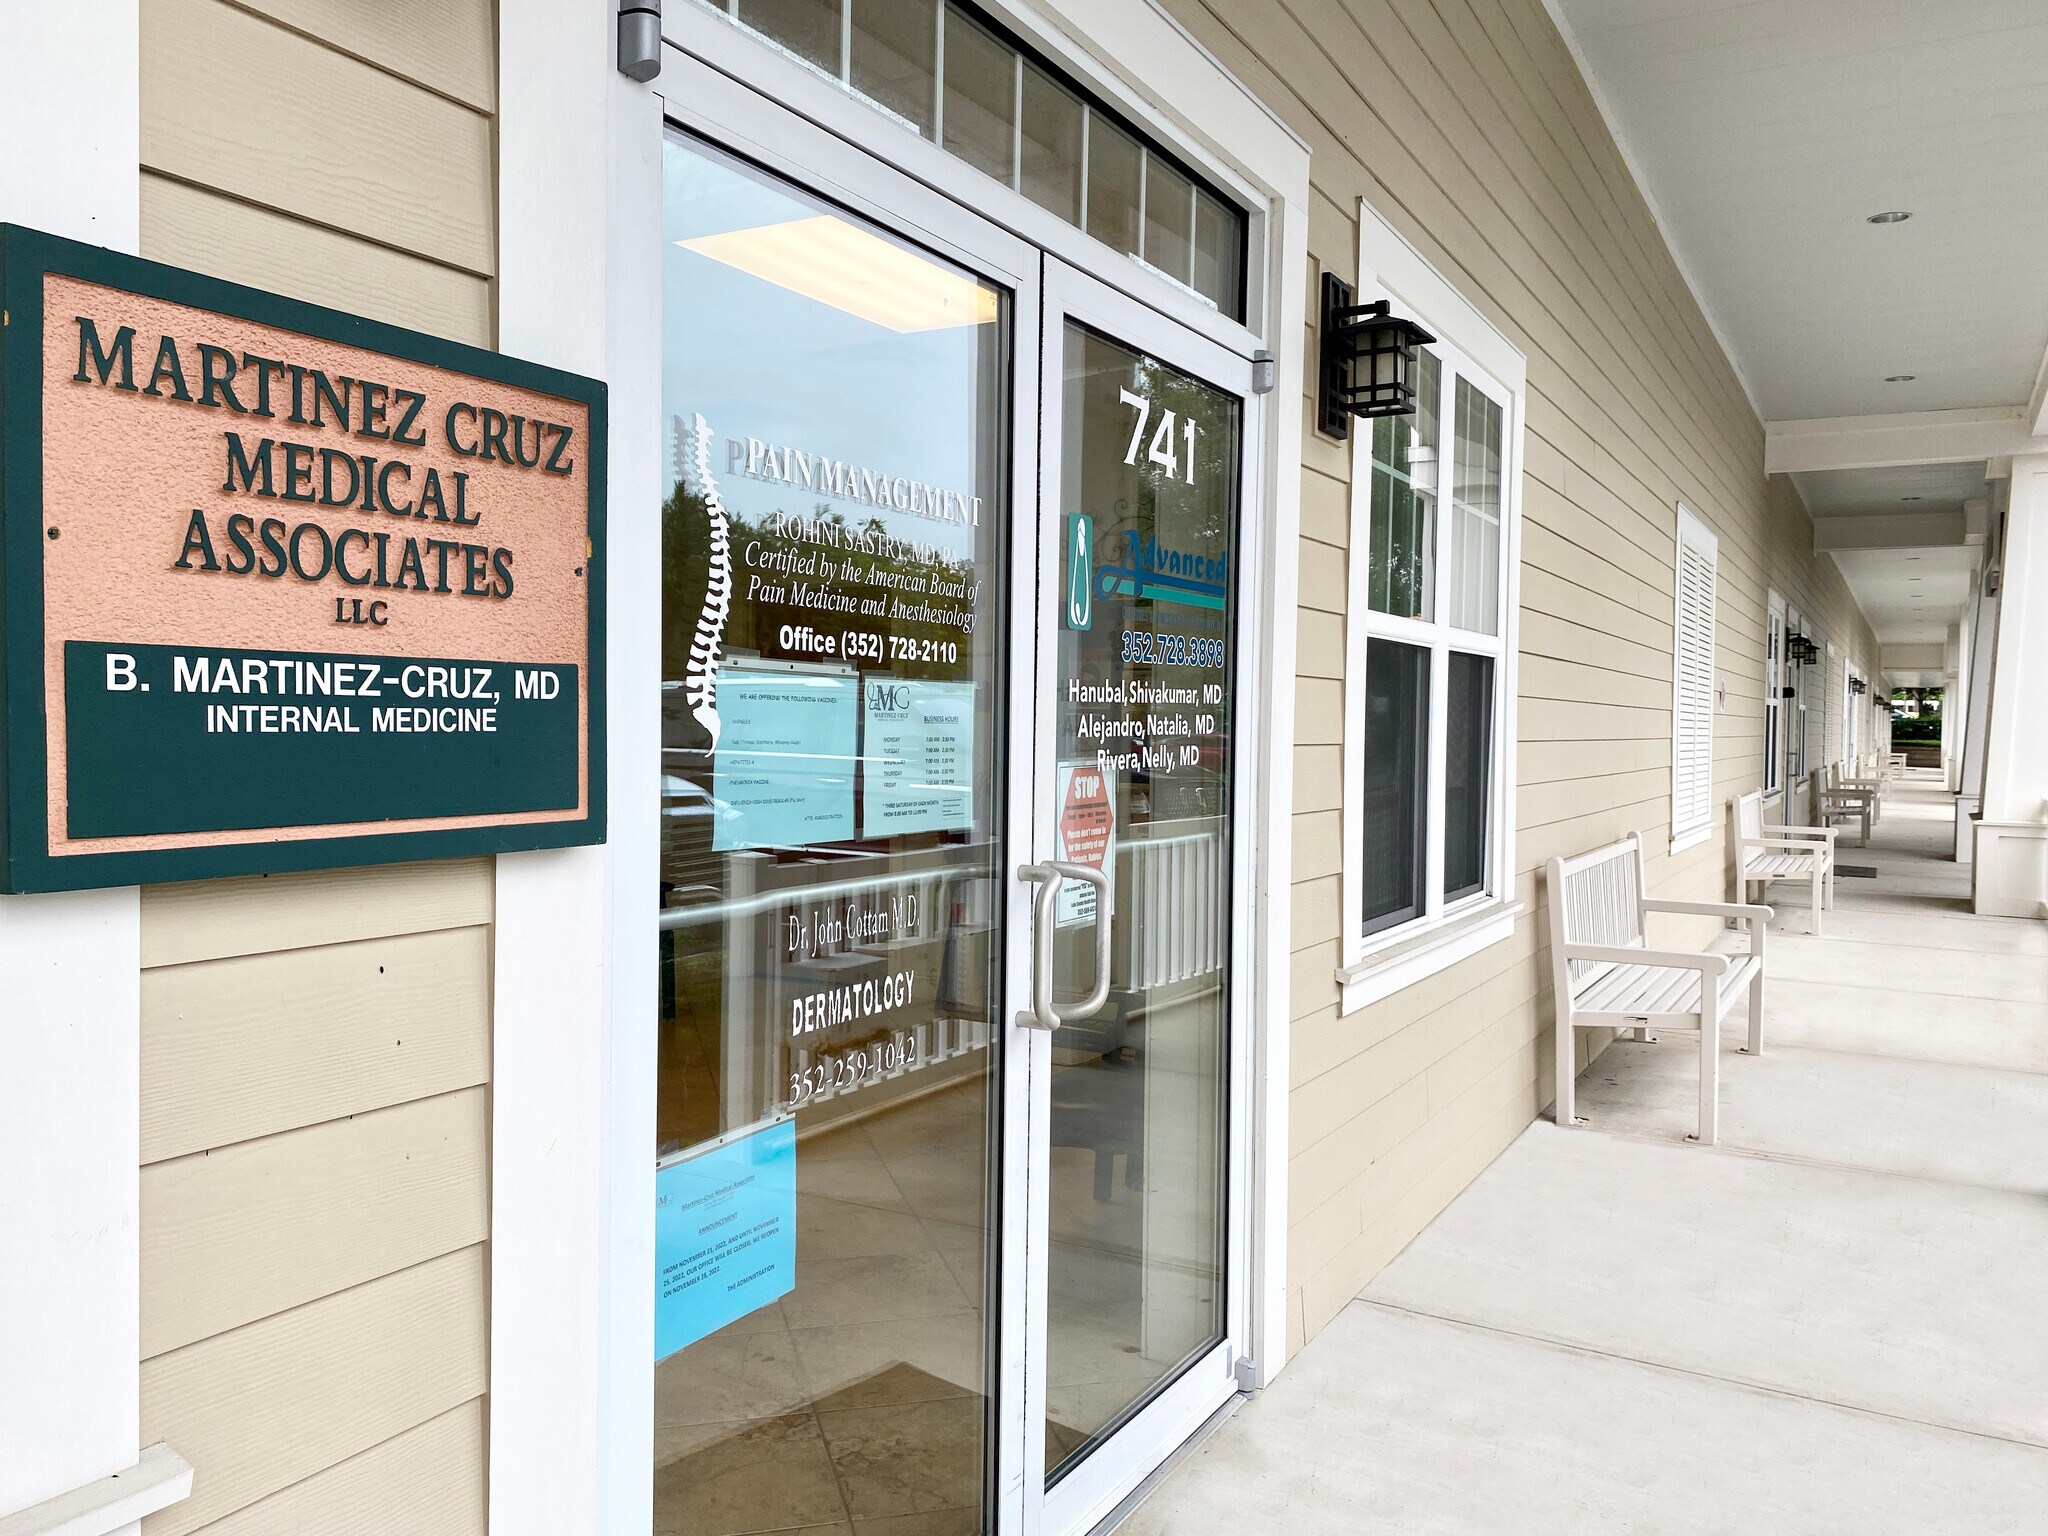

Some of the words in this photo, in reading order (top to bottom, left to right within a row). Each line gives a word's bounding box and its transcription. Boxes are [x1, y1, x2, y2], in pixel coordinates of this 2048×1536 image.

[73, 315, 427, 447] MARTINEZ
[445, 401, 574, 476] CRUZ
[1119, 385, 1196, 485] 741
[223, 431, 482, 526] MEDICAL
[745, 436, 813, 487] PAIN
[819, 455, 983, 527] MANAGEMENT
[175, 509, 515, 600] ASSOCIATES
[775, 511, 841, 549] ROHINI
[745, 541, 815, 578] Certified
[819, 550, 837, 585] by
[840, 556, 862, 583] the
[864, 564, 927, 593] American
[929, 572, 965, 599] Board
[967, 580, 982, 607] of
[1098, 529, 1226, 598] Advanced
[335, 598, 389, 626] LLC
[746, 574, 786, 605] Pain
[789, 580, 857, 613] Medicine
[860, 593, 885, 616] and
[887, 600, 978, 635] Anesthesiology
[779, 624, 836, 654] Office
[840, 630, 884, 664] (352)
[888, 636, 957, 664] 728-2110
[1121, 630, 1224, 668] 352.728.3898
[106, 653, 150, 692] B.
[173, 656, 501, 704] MARTINEZ-CRUZ,
[515, 670, 560, 700] MD
[1203, 684, 1222, 705] MD
[206, 704, 360, 733] INTERNAL
[372, 706, 498, 732] MEDICINE
[1195, 714, 1214, 735] MD
[1179, 745, 1199, 767] MD
[1074, 776, 1100, 799] STOP
[789, 915, 808, 951] Dr.
[812, 906, 842, 957] John
[846, 904, 888, 939] Cottam
[892, 894, 920, 930] M.D.
[792, 969, 915, 1037] DERMATOLOGY
[789, 1035, 916, 1105] 352-259-1042
[663, 1264, 678, 1276] FROM
